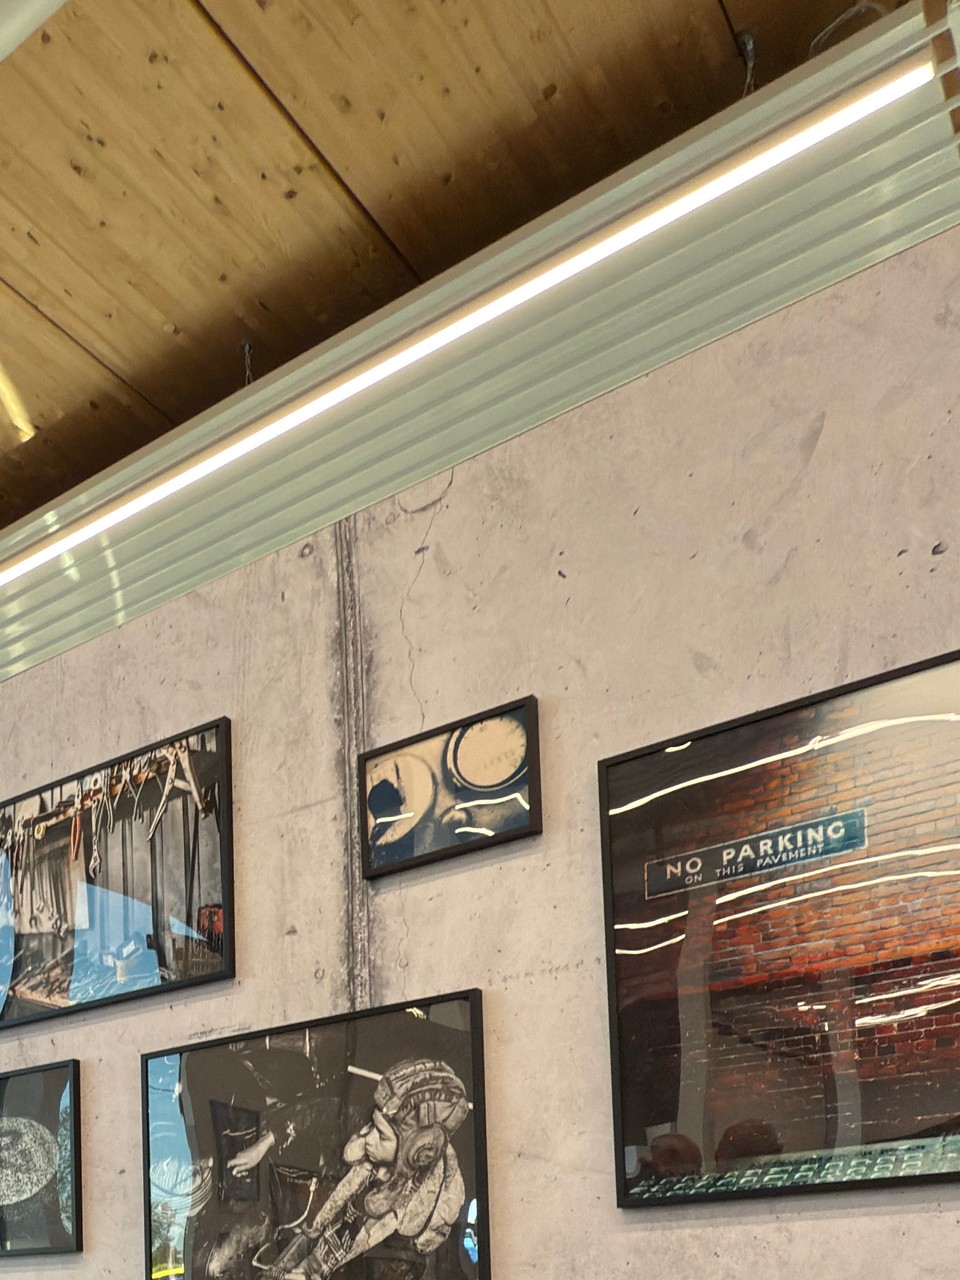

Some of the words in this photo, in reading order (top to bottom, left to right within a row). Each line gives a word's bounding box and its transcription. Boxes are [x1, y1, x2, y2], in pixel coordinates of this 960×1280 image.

[665, 856, 703, 880] NO
[722, 820, 846, 866] PARKING
[684, 873, 703, 885] ON
[714, 864, 744, 878] THIS
[756, 843, 825, 868] PAVEMENT
